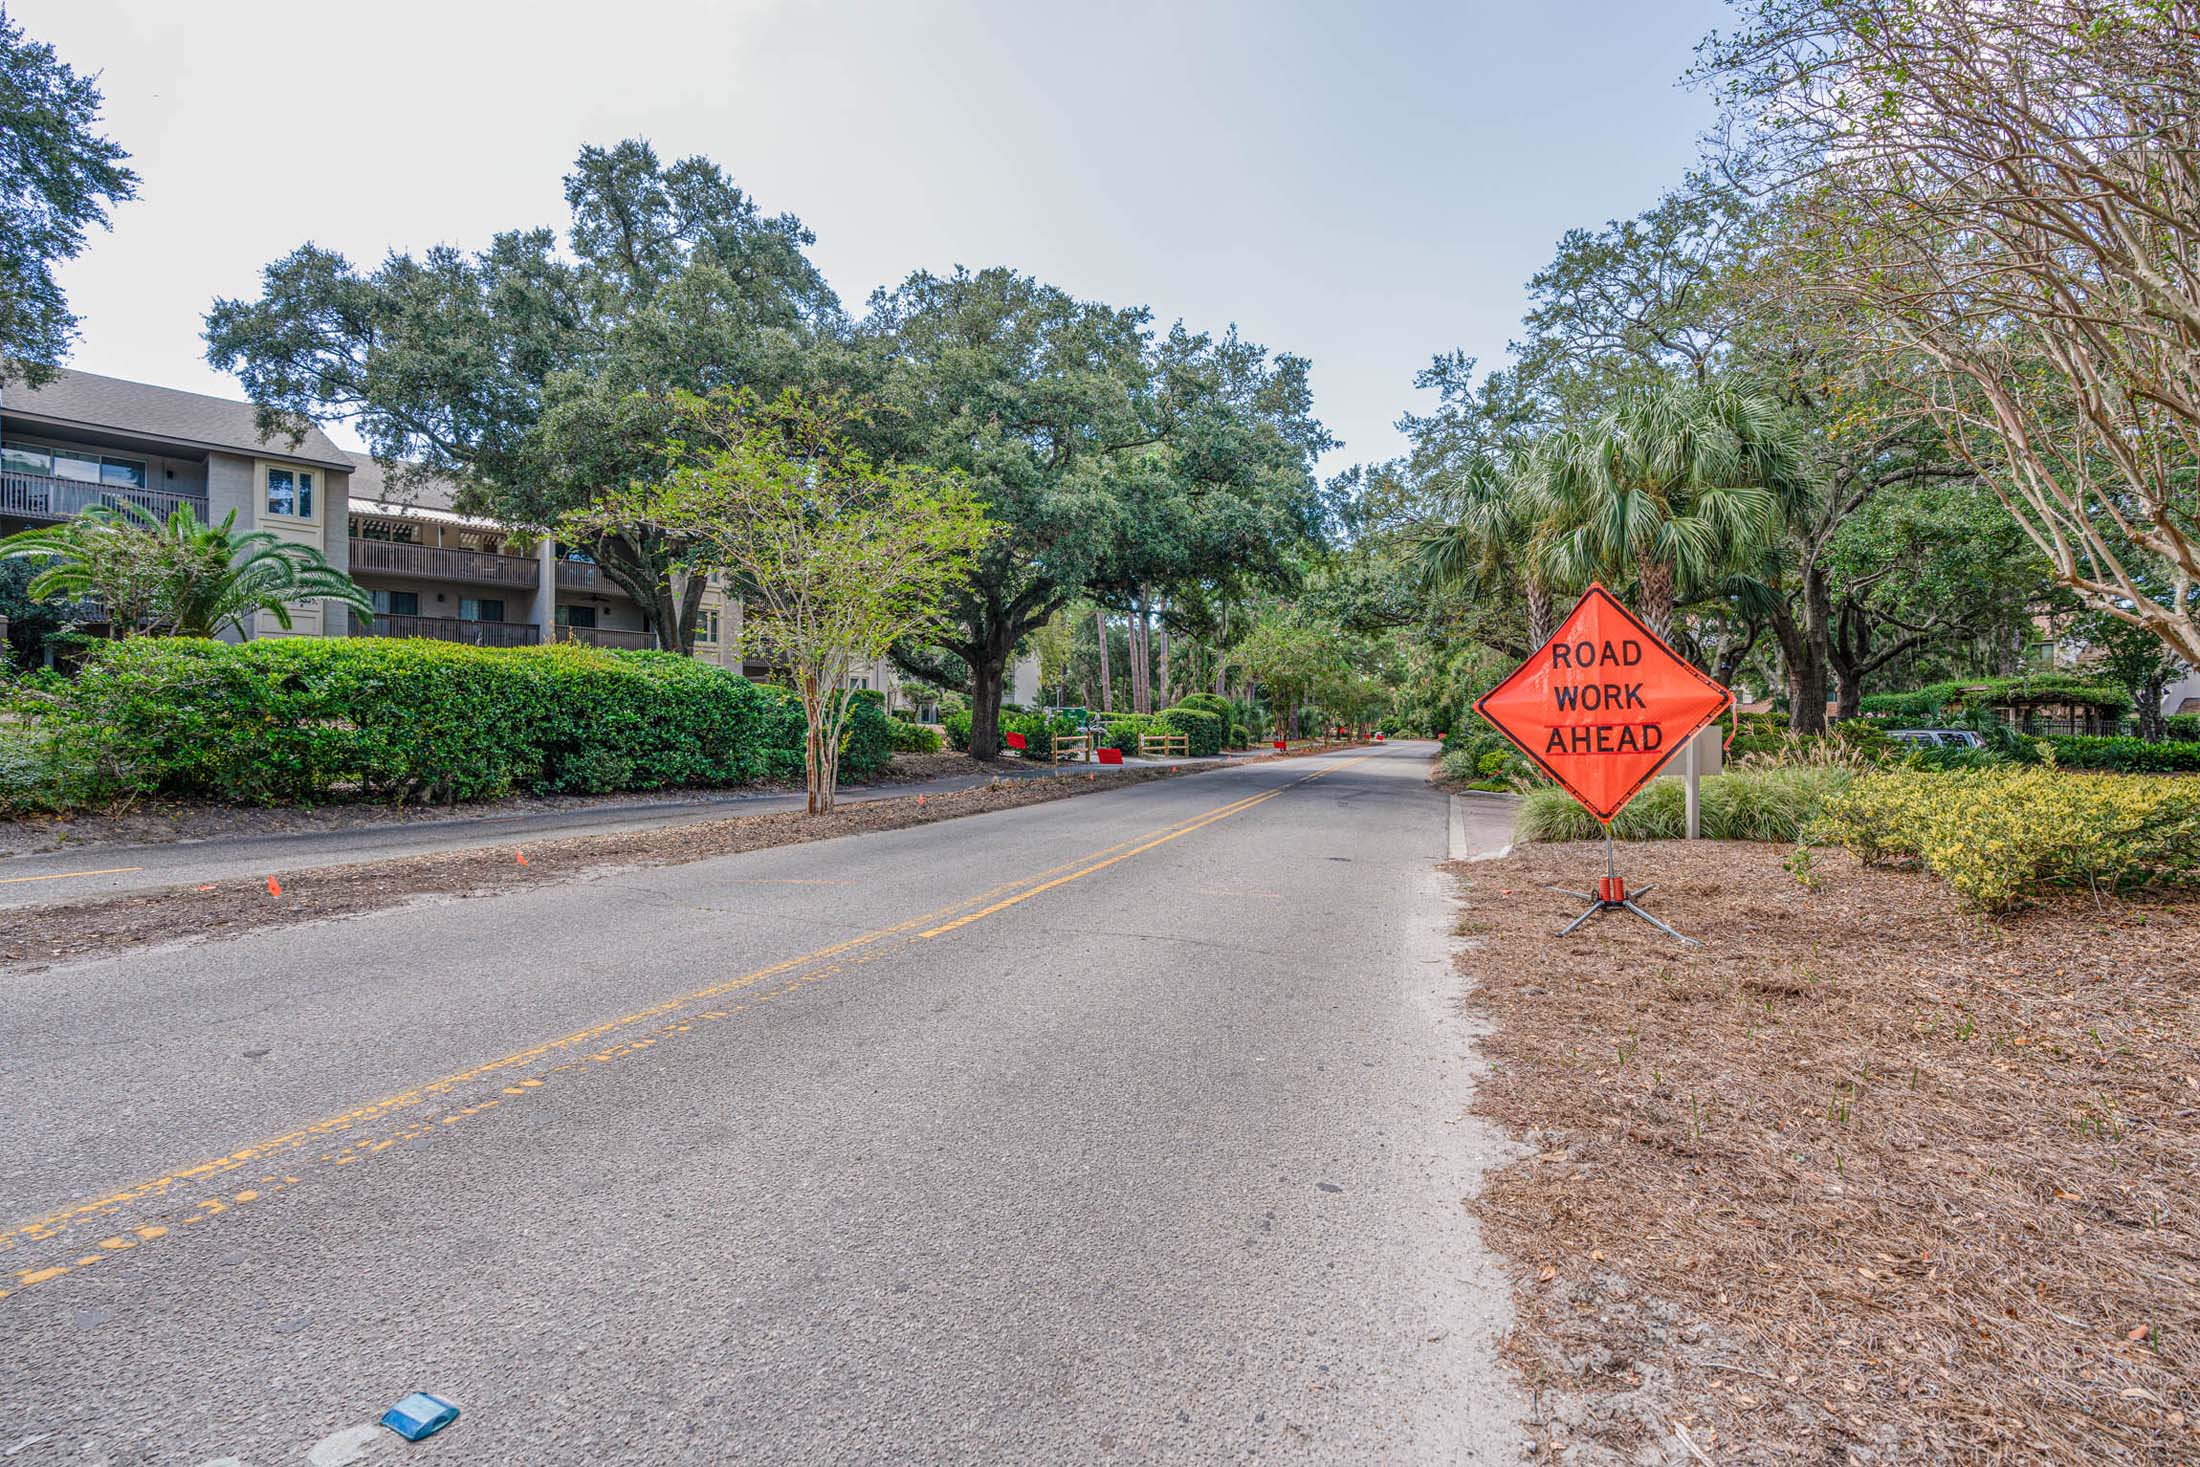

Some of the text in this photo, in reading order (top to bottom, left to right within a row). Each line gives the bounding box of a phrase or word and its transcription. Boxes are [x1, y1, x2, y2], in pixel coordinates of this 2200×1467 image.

[1552, 640, 1642, 669] ROAD
[1554, 683, 1646, 711] WORK
[1545, 724, 1663, 753] AHEAD
